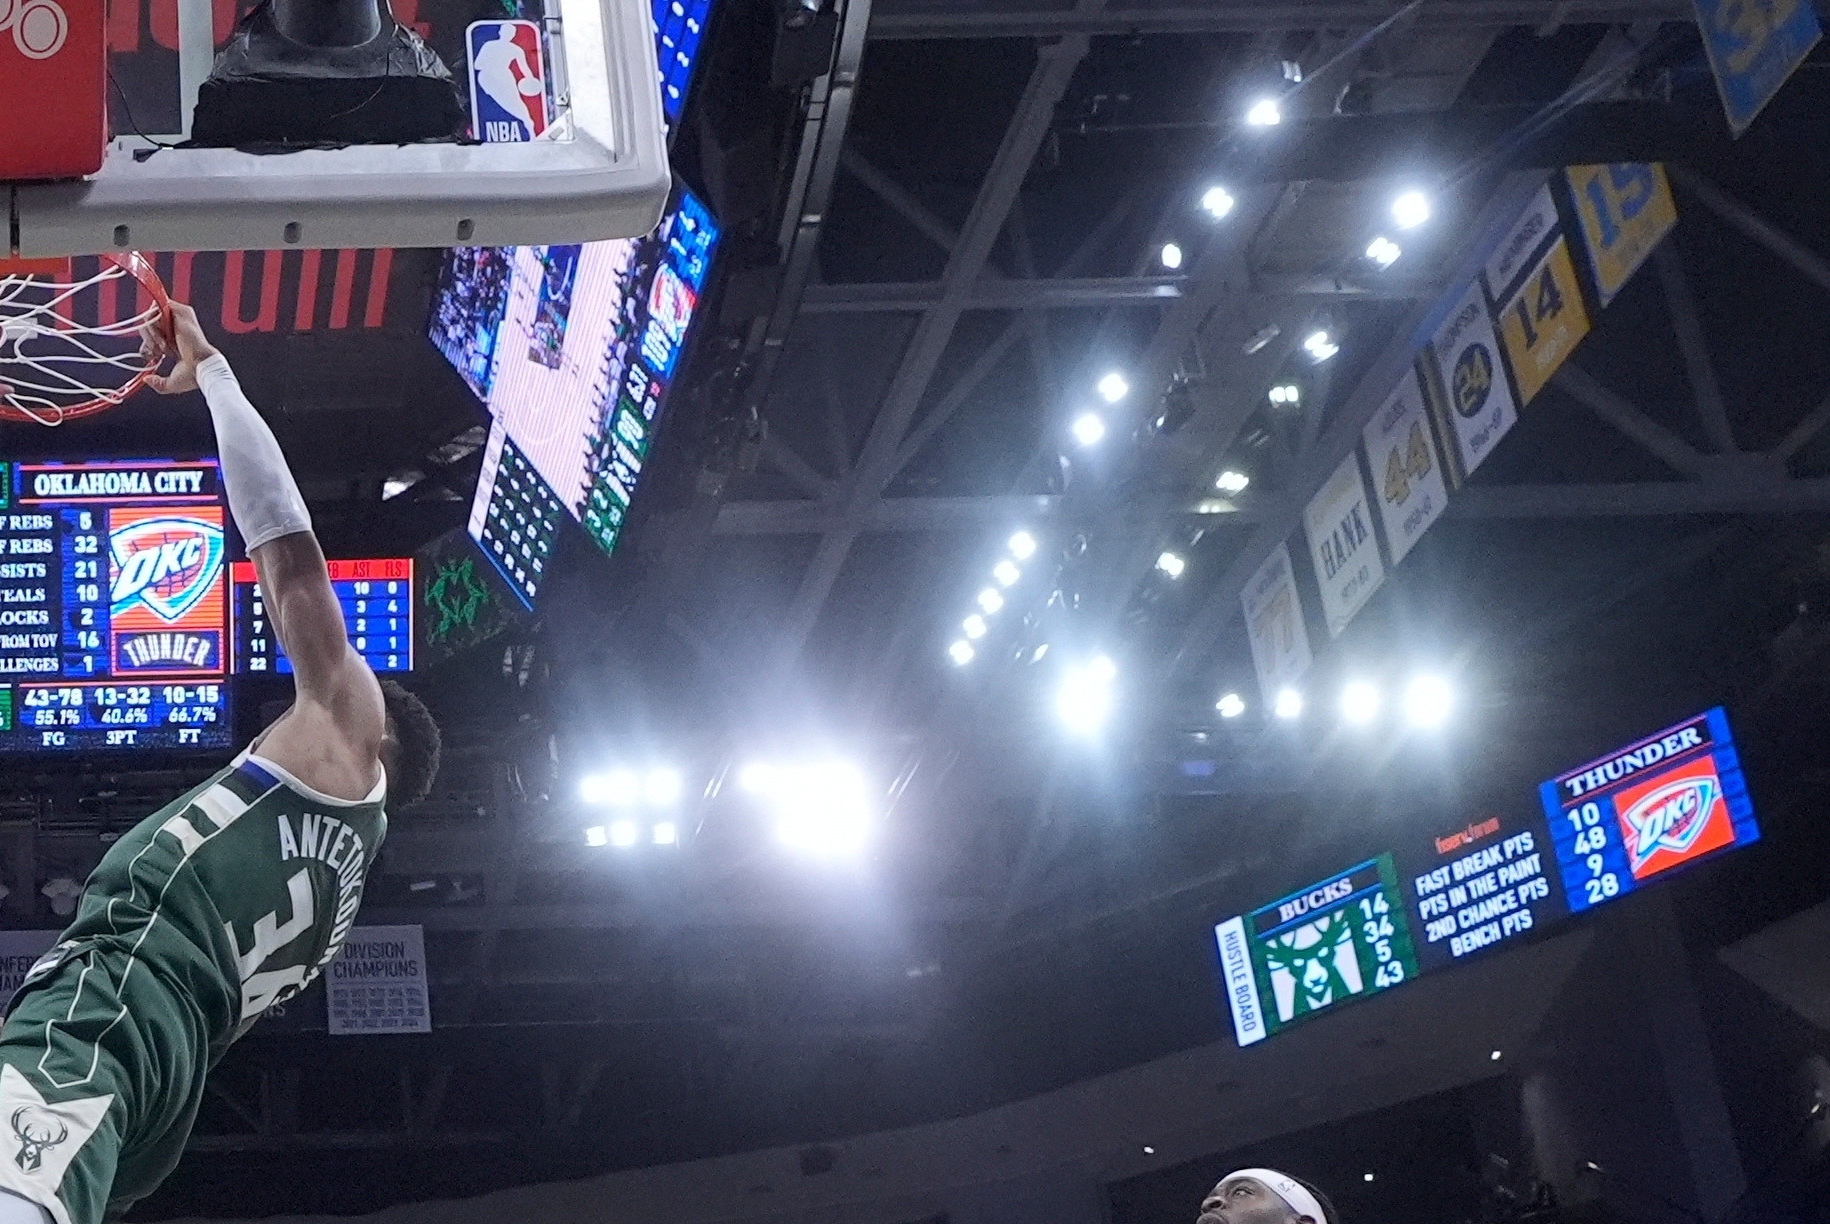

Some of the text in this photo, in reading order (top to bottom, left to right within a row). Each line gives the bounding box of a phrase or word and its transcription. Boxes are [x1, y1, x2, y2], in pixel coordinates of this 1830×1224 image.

[485, 121, 521, 143] NBA
[1518, 263, 1564, 351] 14
[1384, 420, 1431, 505] 44
[35, 470, 202, 495] OKLAHOMA CITY
[10, 515, 53, 530] REBS
[80, 512, 92, 530] 5
[10, 539, 53, 553] REBS
[75, 536, 97, 553] 32
[1320, 500, 1369, 580] HANK
[75, 561, 97, 578] 21
[352, 562, 370, 577] AST
[385, 562, 402, 577] FLS
[77, 585, 98, 602] 10
[81, 608, 93, 625] 2
[31, 634, 58, 648] TOV
[77, 631, 100, 649] 16
[122, 633, 211, 669] THUNDER
[83, 656, 92, 672] 1
[24, 688, 83, 707] 43-78
[94, 687, 151, 705] 13-32
[162, 685, 219, 704] 10-15
[34, 709, 80, 726] 55.1%
[101, 708, 148, 724] 40.6%
[168, 707, 216, 723] 66.7%
[42, 732, 65, 746] FG
[106, 730, 137, 744] 3PT
[179, 728, 201, 743] FT
[1565, 727, 1702, 797] THUNDER
[1568, 802, 1600, 831] 10
[1574, 826, 1607, 855] 48
[1415, 831, 1534, 896] FAST BREAK PTS
[1586, 853, 1603, 877] 9
[1419, 853, 1541, 920] PTS IN THE PAINT
[1585, 873, 1619, 904] 28
[1278, 877, 1353, 923] BUCKS
[1359, 892, 1390, 920] 14
[1425, 877, 1549, 943] 2ND CHANCE PTS
[1363, 914, 1395, 944] 34
[1450, 909, 1533, 957] BENCH PTS
[344, 941, 405, 959] DIVISION
[1375, 939, 1392, 962] 5
[334, 961, 418, 978] CHAMPIONS
[1224, 930, 1257, 1033] HUSTLE BOARD
[1375, 960, 1404, 988] 43
